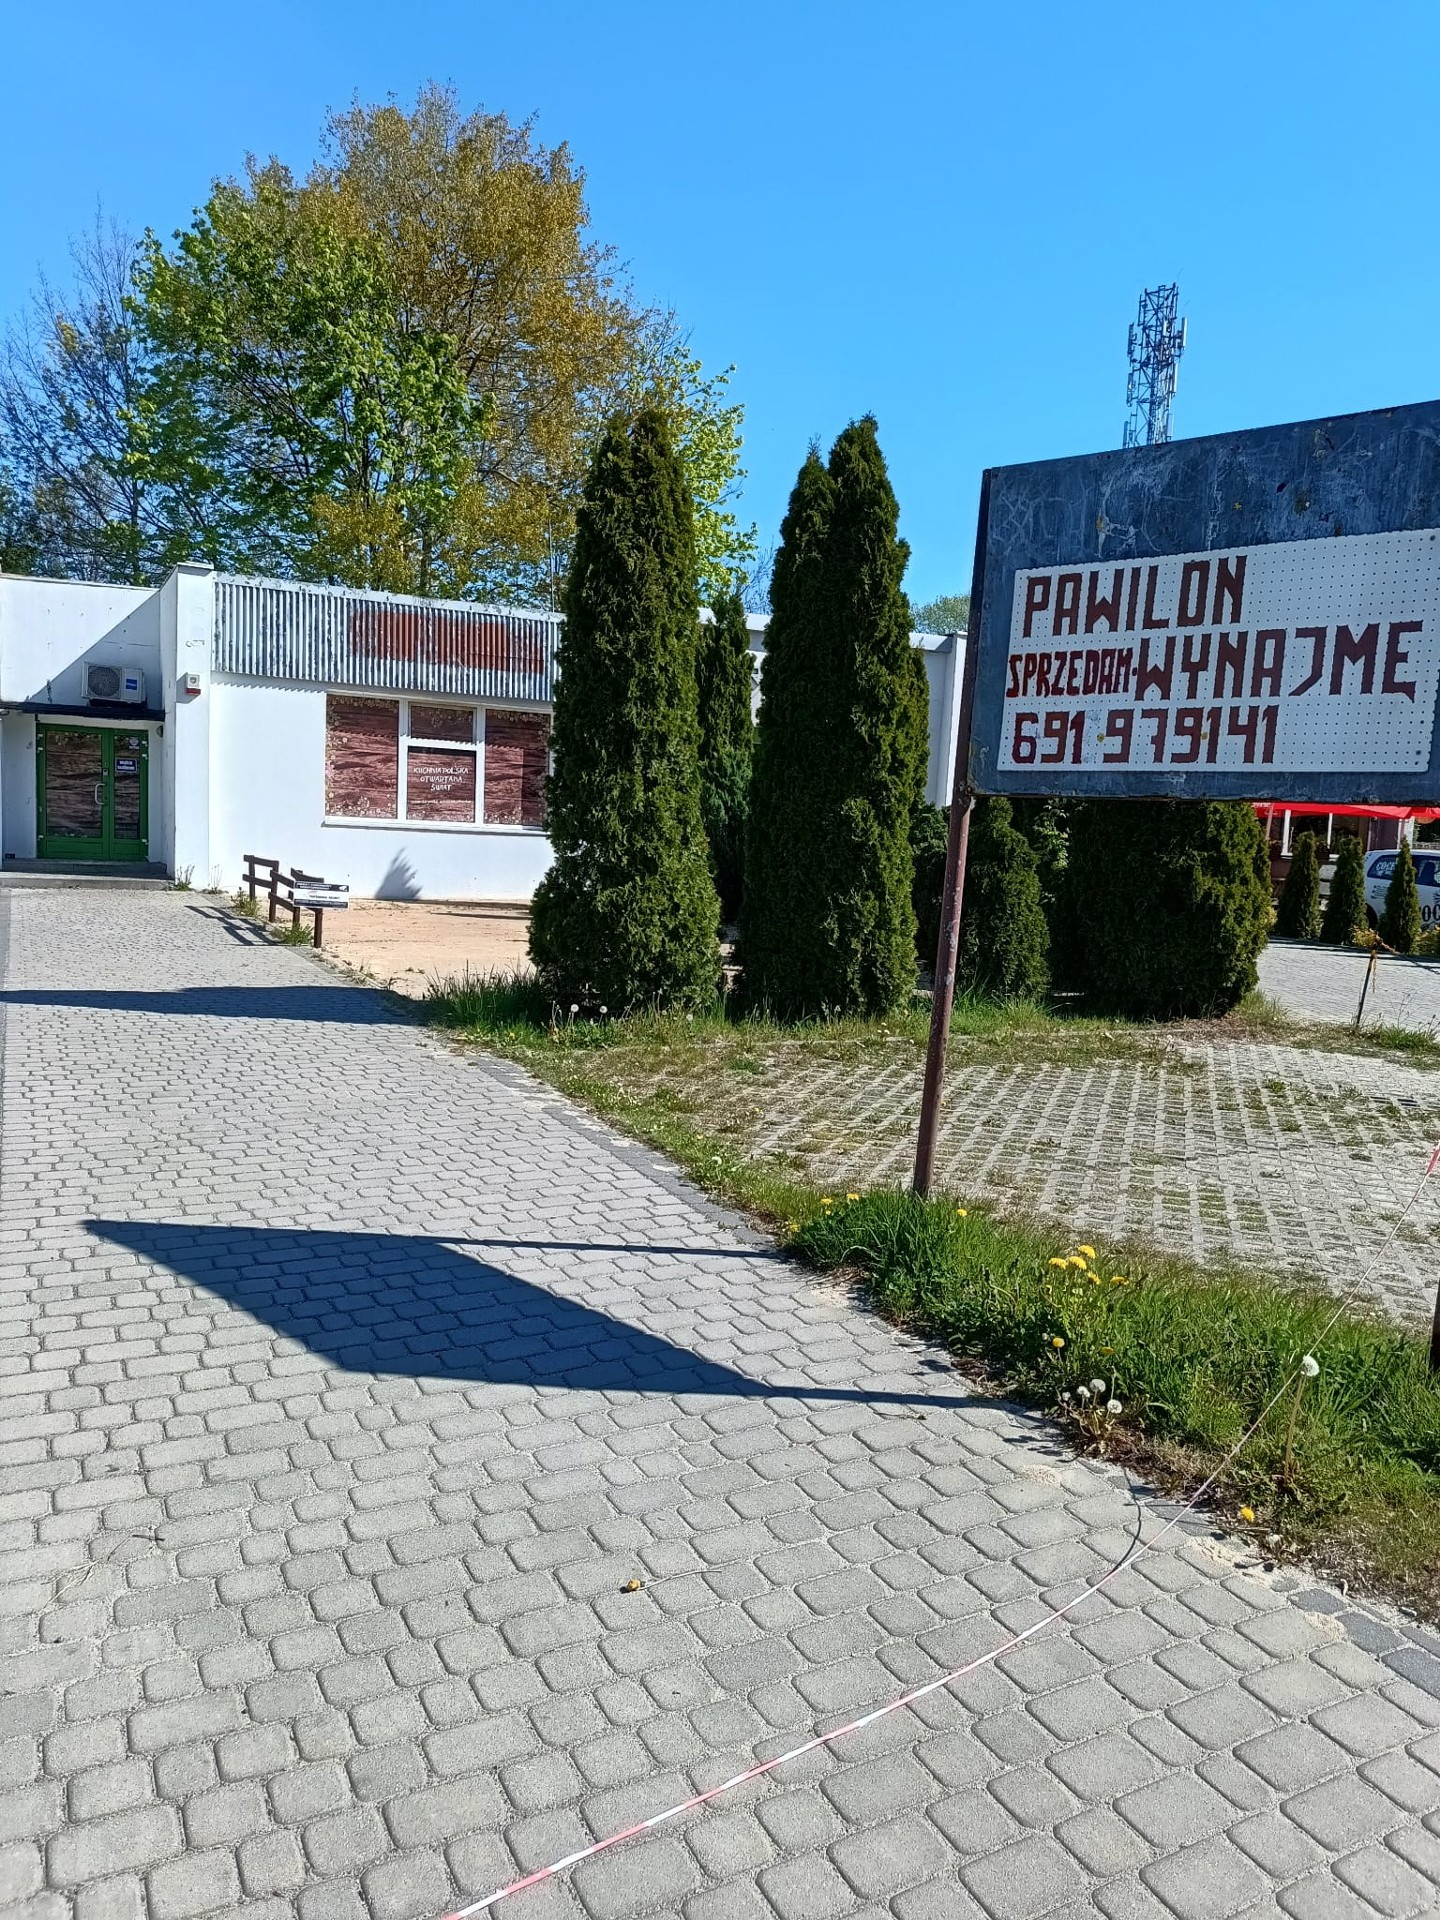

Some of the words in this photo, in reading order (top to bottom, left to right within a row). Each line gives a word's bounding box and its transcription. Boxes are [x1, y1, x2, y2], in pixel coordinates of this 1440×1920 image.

[1022, 555, 1248, 638] PAWILON
[1006, 647, 1133, 699] SPRZEDAM
[1012, 710, 1086, 765] 691
[1103, 704, 1280, 765] 979141
